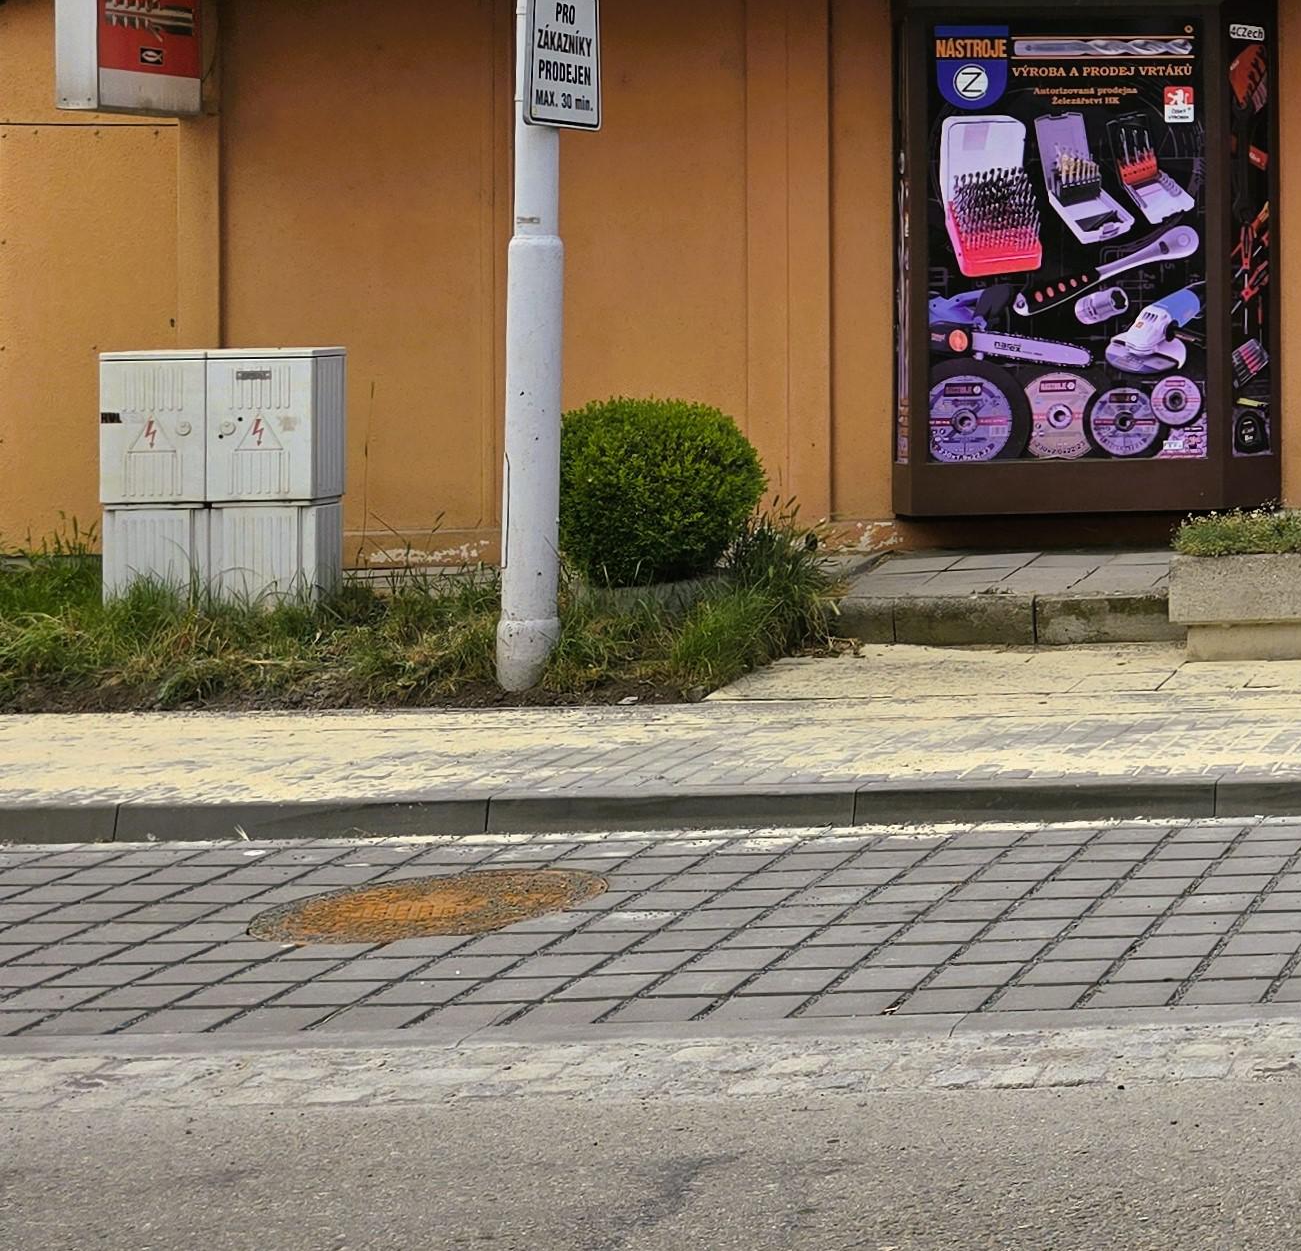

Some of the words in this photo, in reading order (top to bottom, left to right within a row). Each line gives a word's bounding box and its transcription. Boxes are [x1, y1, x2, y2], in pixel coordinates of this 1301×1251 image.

[556, 2, 576, 25] PRO
[537, 24, 592, 57] ZÁKAZNÍKY
[935, 38, 1007, 59] NÁSTROJE
[538, 59, 591, 86] PRODEJEN
[1012, 66, 1066, 77] VÝROBA
[1069, 67, 1079, 76] A
[1083, 66, 1135, 77] PRODEJ
[1139, 63, 1192, 76] VRTÁKŮ
[535, 89, 558, 107] MAX.
[561, 93, 572, 109] 30
[575, 95, 593, 111] min.
[1097, 86, 1138, 96] prodejna
